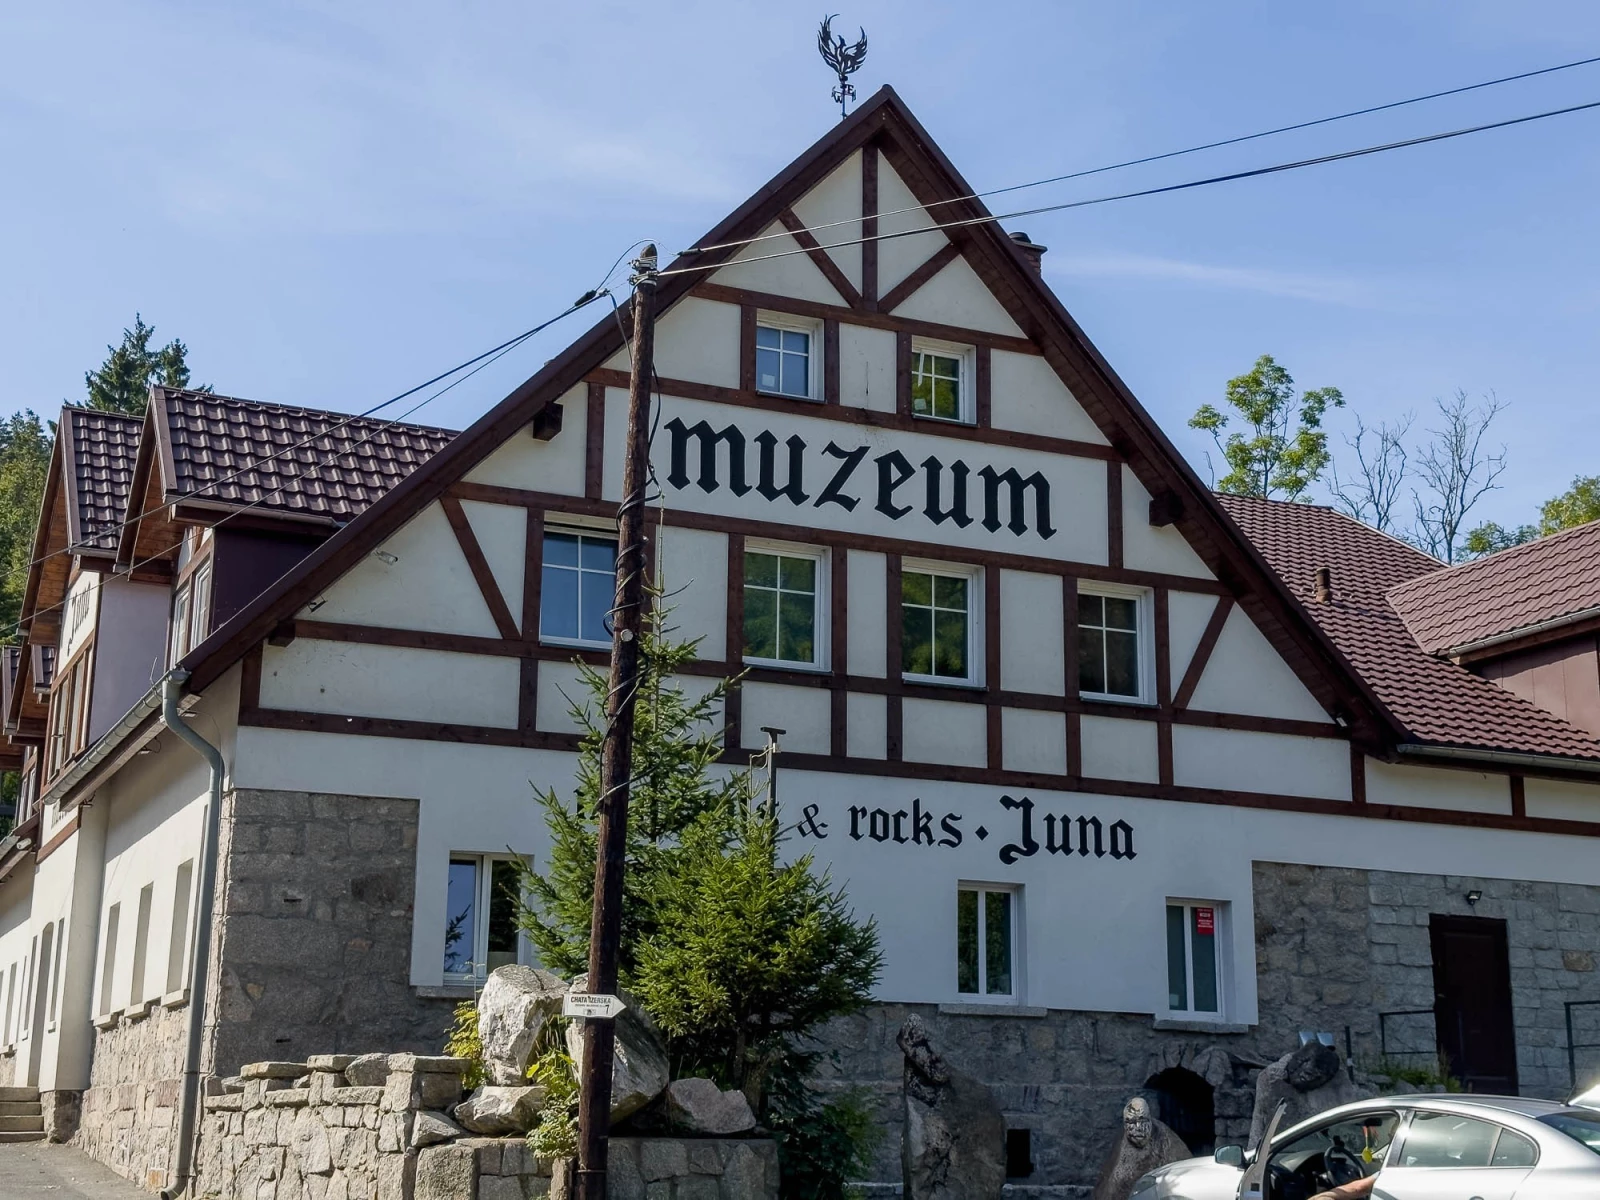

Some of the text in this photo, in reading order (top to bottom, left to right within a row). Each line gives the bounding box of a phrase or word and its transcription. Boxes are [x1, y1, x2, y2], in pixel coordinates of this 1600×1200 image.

[663, 417, 1058, 541] muzeum
[797, 802, 829, 840] &
[848, 797, 963, 848] rocks
[998, 795, 1138, 865] Juna
